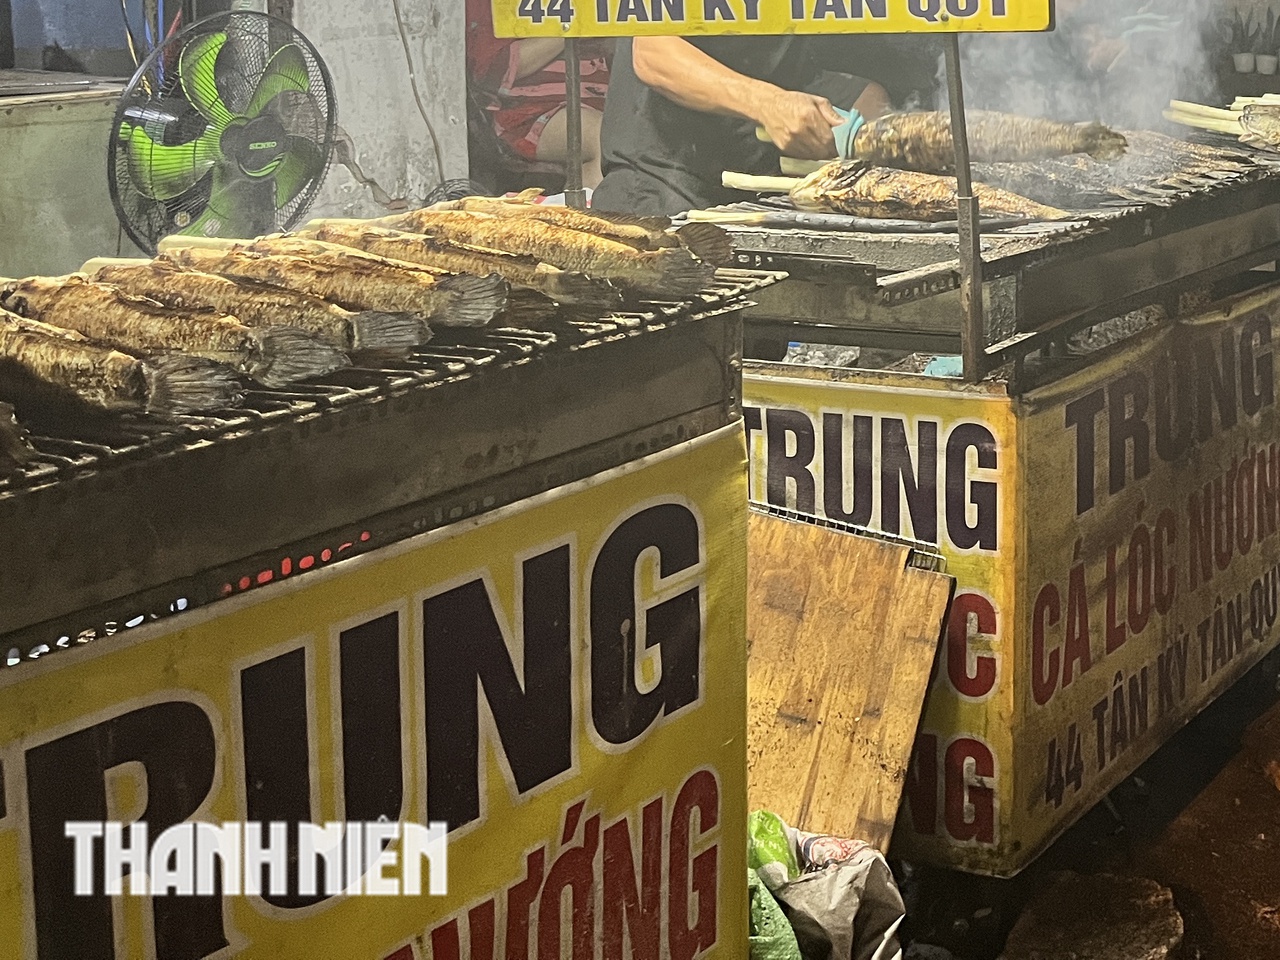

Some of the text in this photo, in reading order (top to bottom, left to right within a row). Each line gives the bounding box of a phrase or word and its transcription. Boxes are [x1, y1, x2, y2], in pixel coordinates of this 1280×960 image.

[1064, 312, 1275, 516] TRUNG
[1031, 536, 1093, 706] CÁ
[1105, 499, 1178, 656] LÓC
[1045, 721, 1085, 810] 44
[1092, 665, 1149, 773] TÂN
[1157, 622, 1190, 716] KỲ
[1197, 593, 1244, 684] TÂN
[0, 502, 702, 960] RUNG
[382, 771, 718, 960] ƯỚNG
